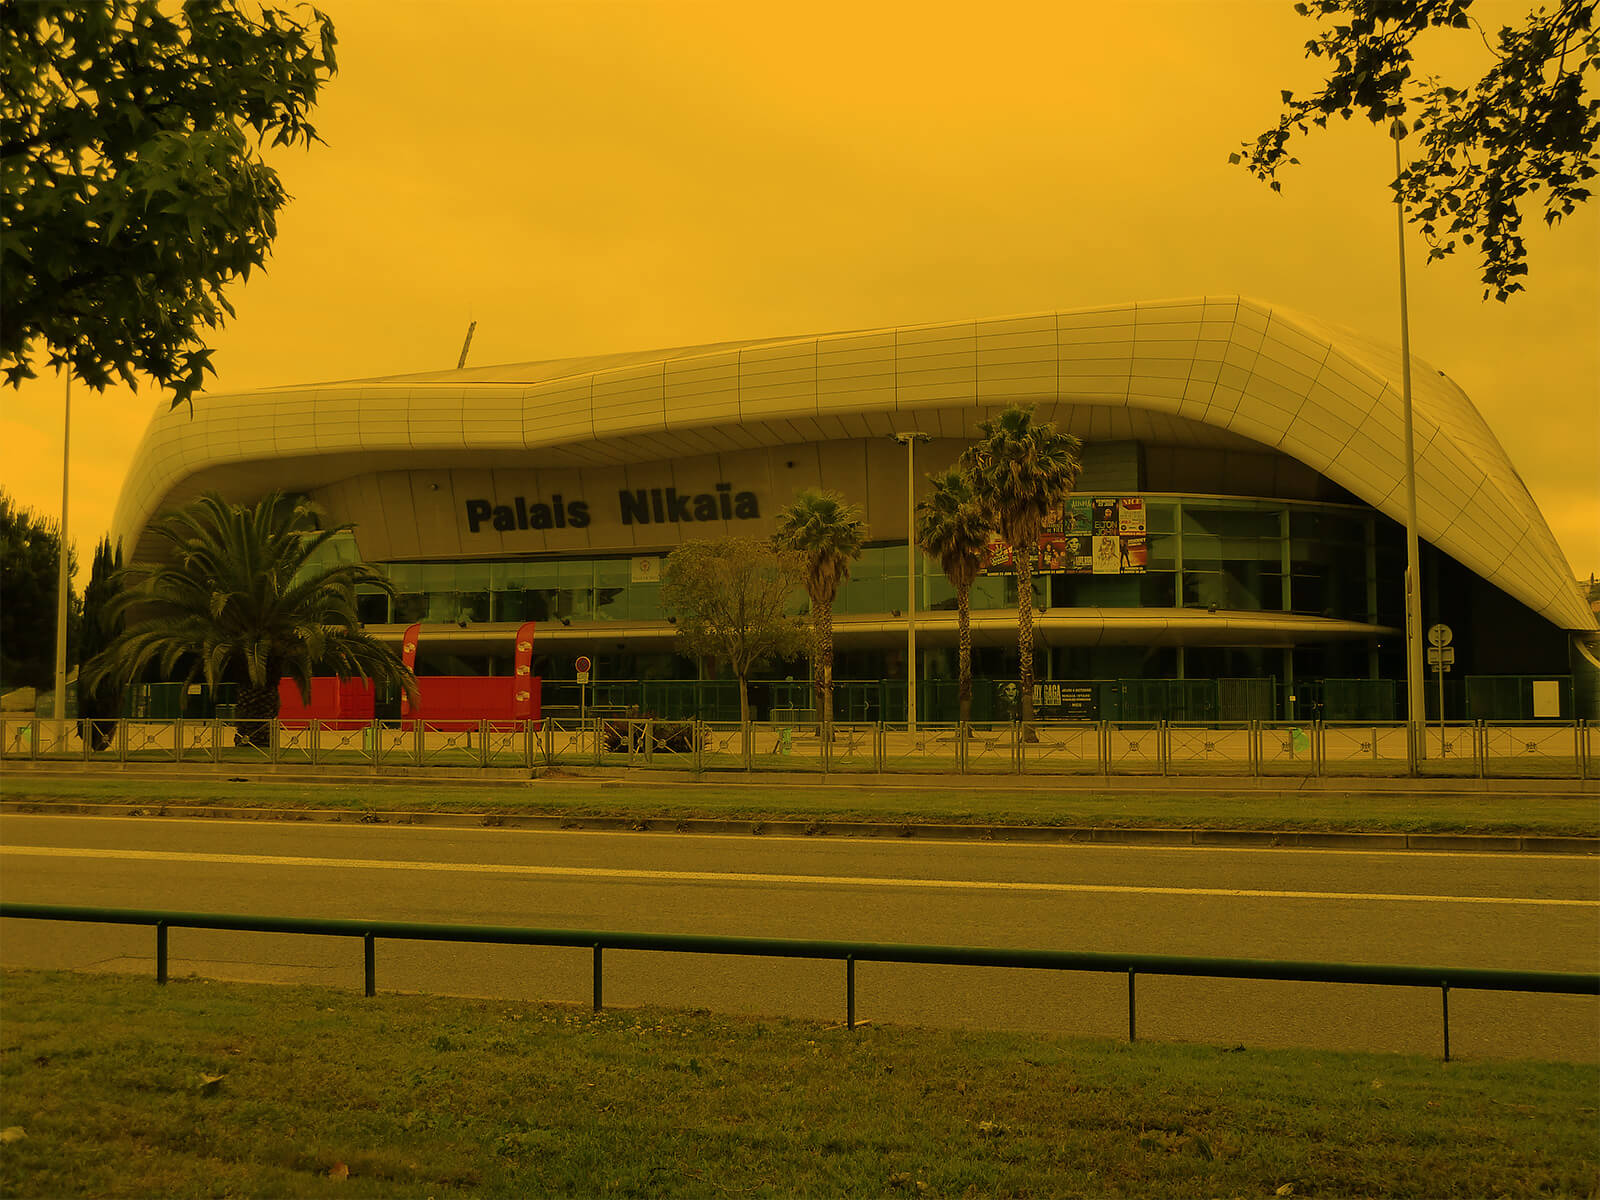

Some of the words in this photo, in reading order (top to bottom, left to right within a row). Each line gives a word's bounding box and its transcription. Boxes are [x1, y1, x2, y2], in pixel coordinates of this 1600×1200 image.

[466, 494, 591, 532] Palais
[618, 481, 760, 525] Nikaïa
[1094, 521, 1117, 529] ELTON
[1044, 684, 1061, 702] GAGA
